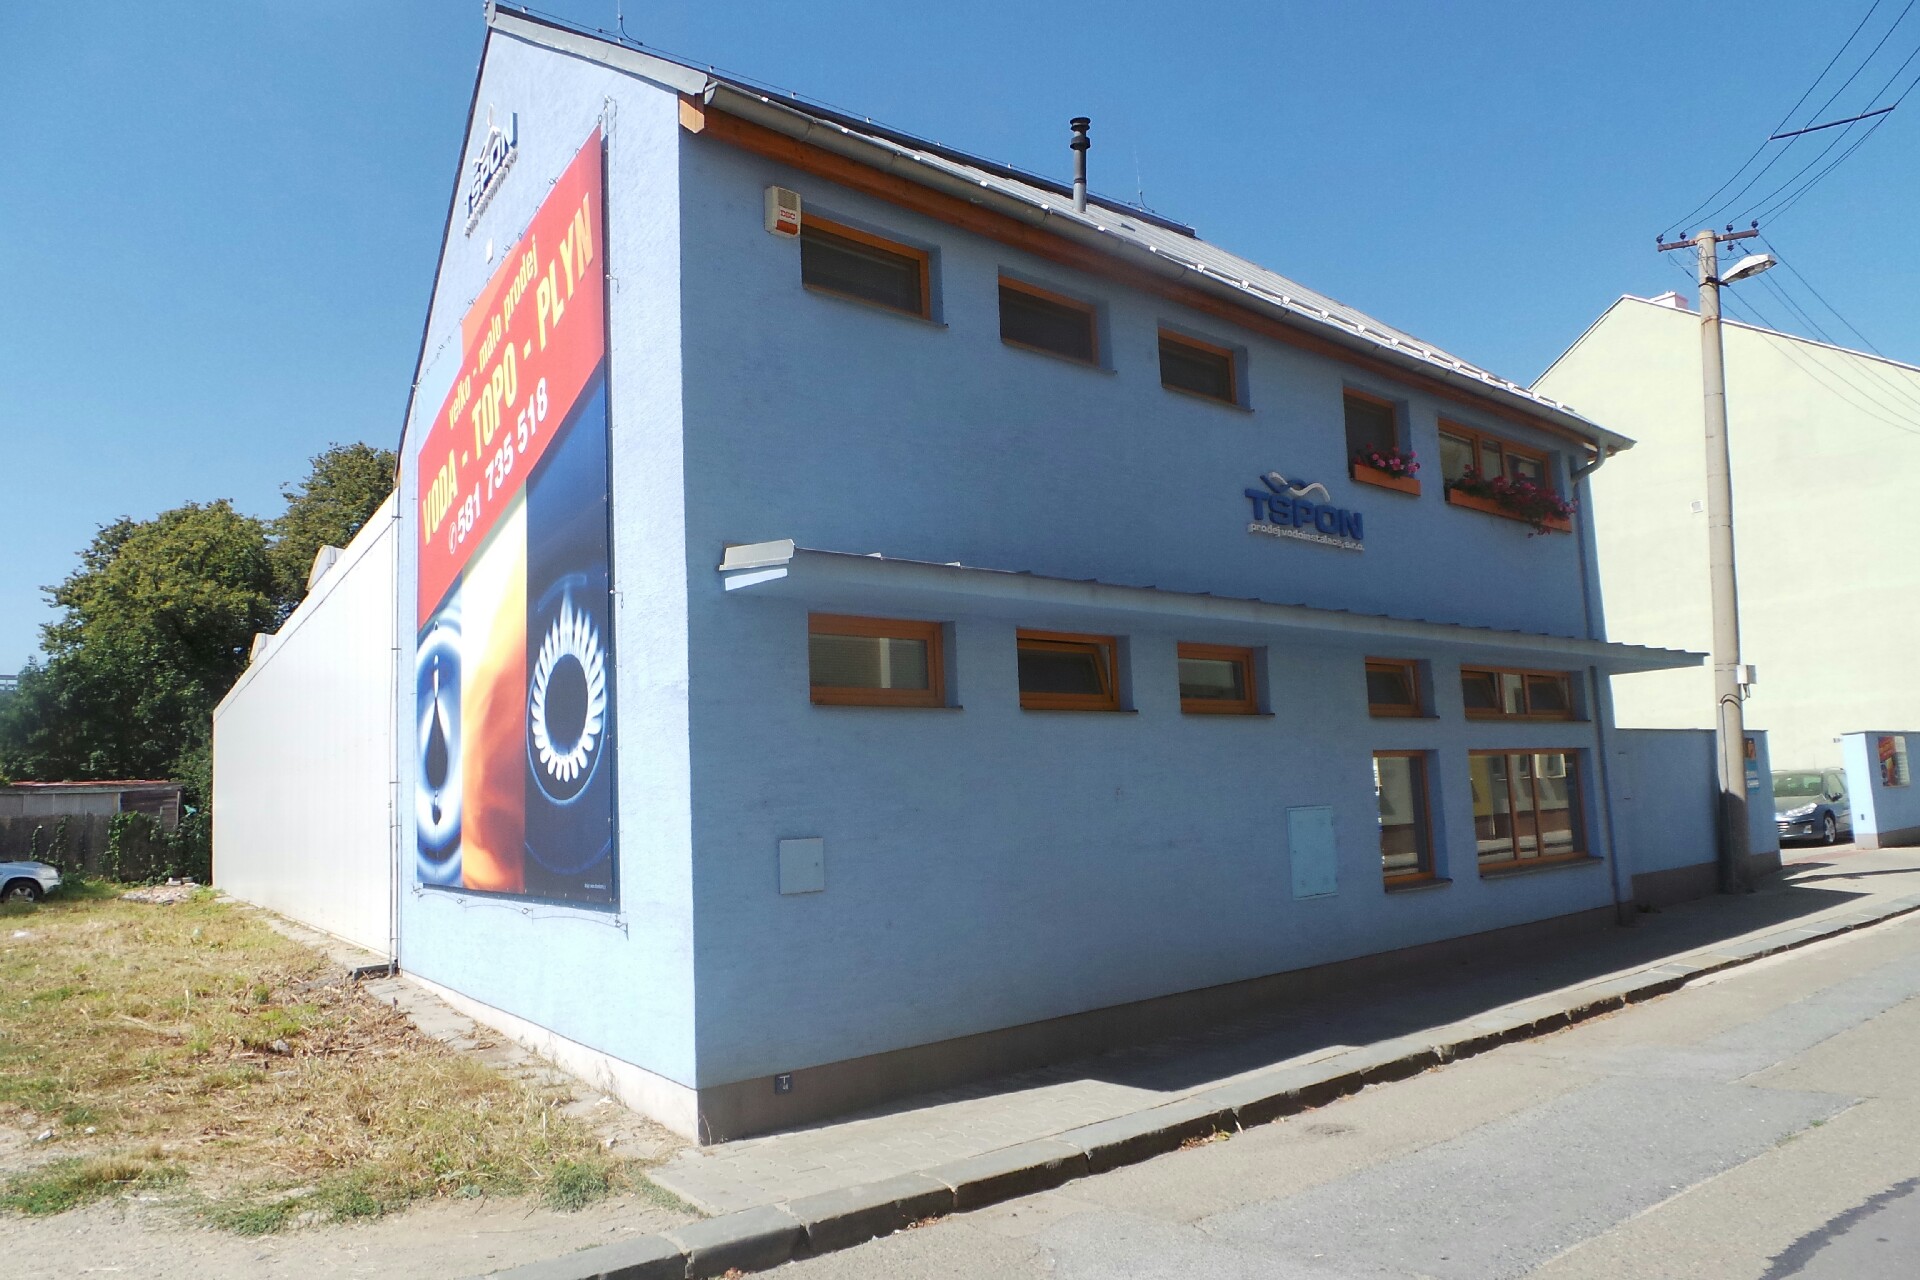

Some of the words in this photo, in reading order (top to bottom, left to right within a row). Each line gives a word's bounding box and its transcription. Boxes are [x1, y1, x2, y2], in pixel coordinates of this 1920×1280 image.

[423, 449, 458, 545] VODA
[472, 342, 517, 460] TOPO
[536, 192, 593, 352] PLYN
[449, 375, 471, 430] velko
[479, 313, 501, 373] malo
[503, 234, 538, 333] prodej
[458, 482, 480, 543] 581
[485, 432, 514, 501] 735
[517, 377, 548, 453] 518
[1248, 522, 1281, 537] prodej
